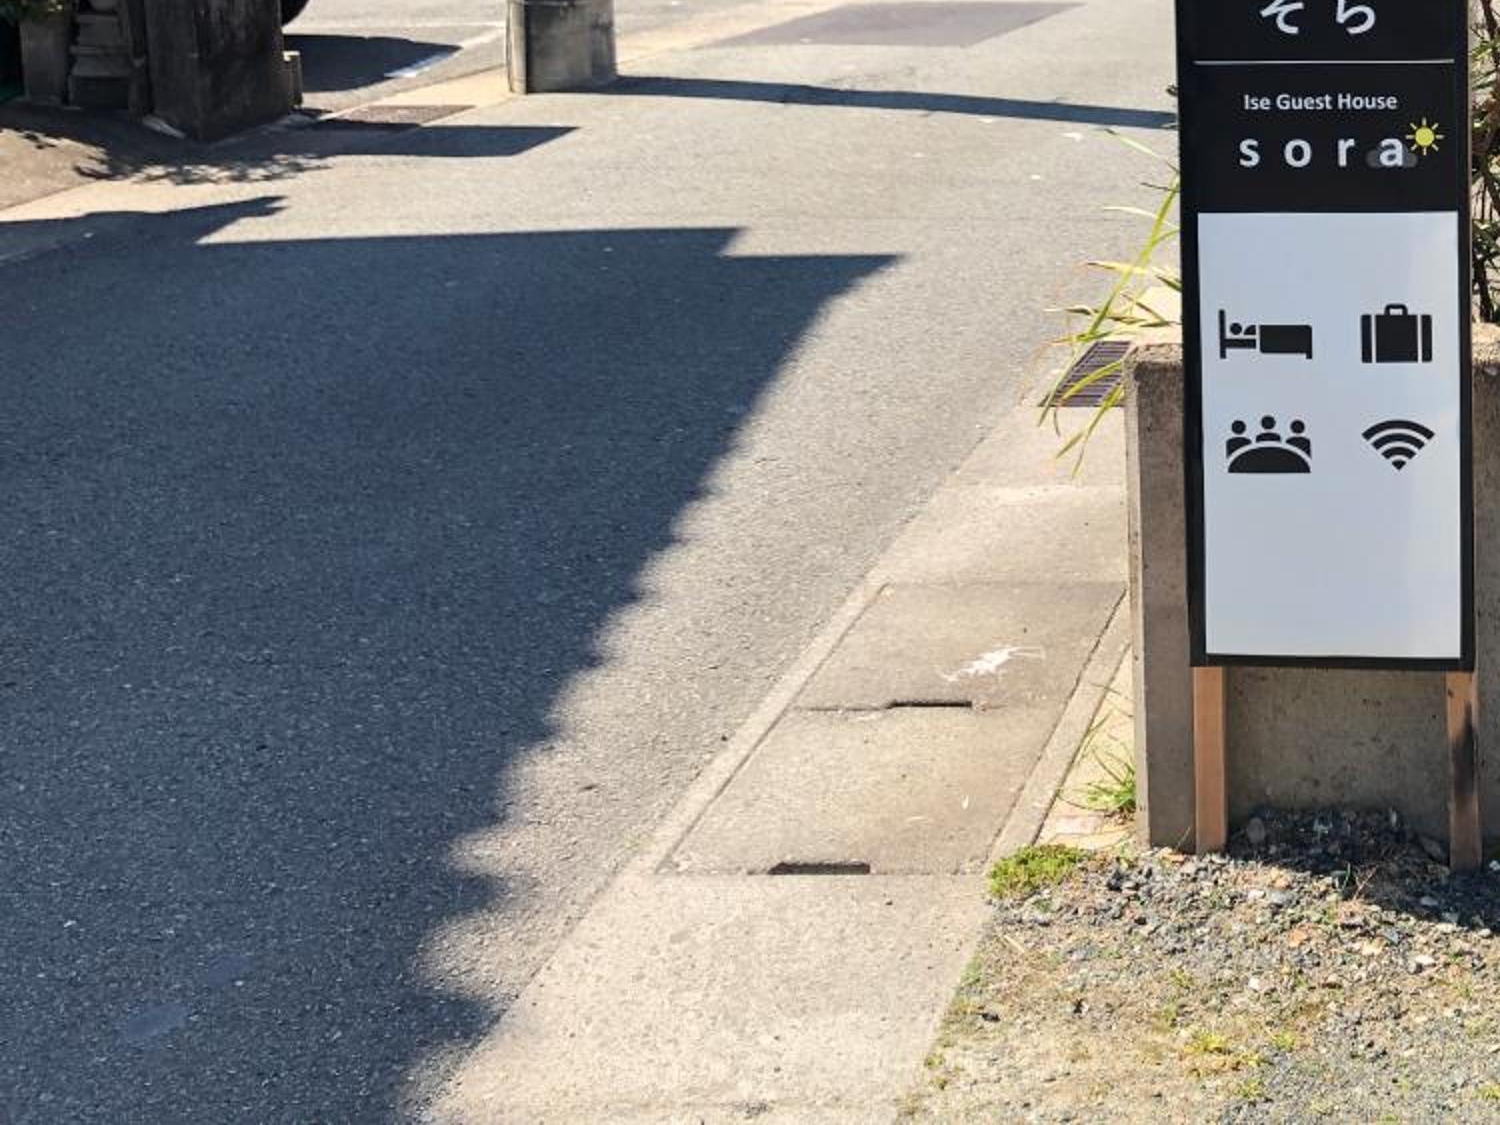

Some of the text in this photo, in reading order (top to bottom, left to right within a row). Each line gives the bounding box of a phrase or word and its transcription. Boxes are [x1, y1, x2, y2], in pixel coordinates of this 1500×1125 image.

[1243, 93, 1398, 110] Ise Guest House
[1239, 138, 1404, 168] sora
